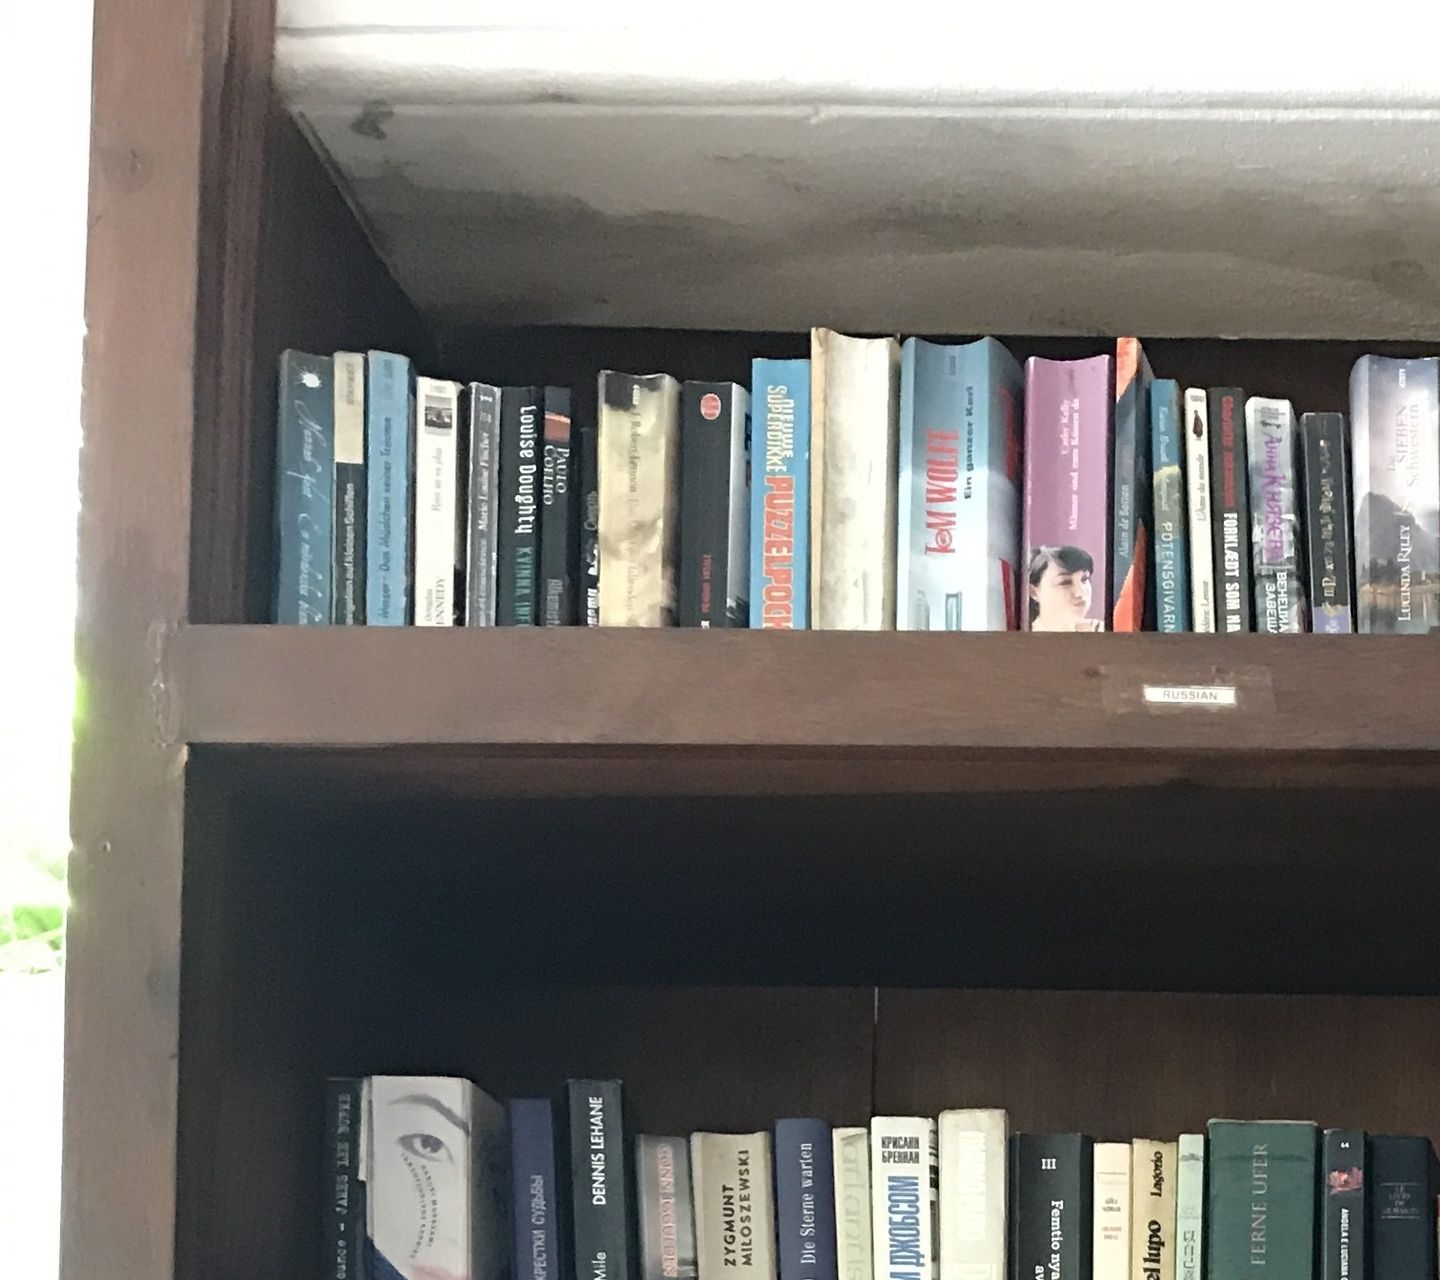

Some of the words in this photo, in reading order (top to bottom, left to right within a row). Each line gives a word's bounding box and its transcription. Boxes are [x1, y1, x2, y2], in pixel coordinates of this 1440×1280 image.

[518, 406, 538, 459] Louise
[542, 445, 558, 505] COELHO
[556, 447, 571, 494] PAULO
[514, 464, 537, 534] Doughty
[1222, 512, 1240, 577] FORKLÆDT
[1398, 524, 1412, 563] RILEY
[1225, 583, 1241, 609] SOM
[1398, 565, 1412, 621] LUCINDA
[1163, 689, 1219, 702] RUSSIAN
[588, 1096, 605, 1150] LEHANE
[590, 1152, 607, 1206] DENNIS
[798, 1142, 815, 1188] warten
[1149, 1150, 1166, 1198] Lagorio
[1252, 1143, 1269, 1196] UFER
[721, 1184, 737, 1267] ZYGMUNT
[737, 1149, 754, 1268] MIŁOSZEWSKI
[799, 1191, 816, 1237] Sterne
[887, 1175, 926, 1268] ДЖОБСОМ
[1049, 1199, 1065, 1251] Femtio
[1250, 1202, 1268, 1266] FERNE
[800, 1240, 817, 1264] Die
[1143, 1219, 1166, 1265] lupo
